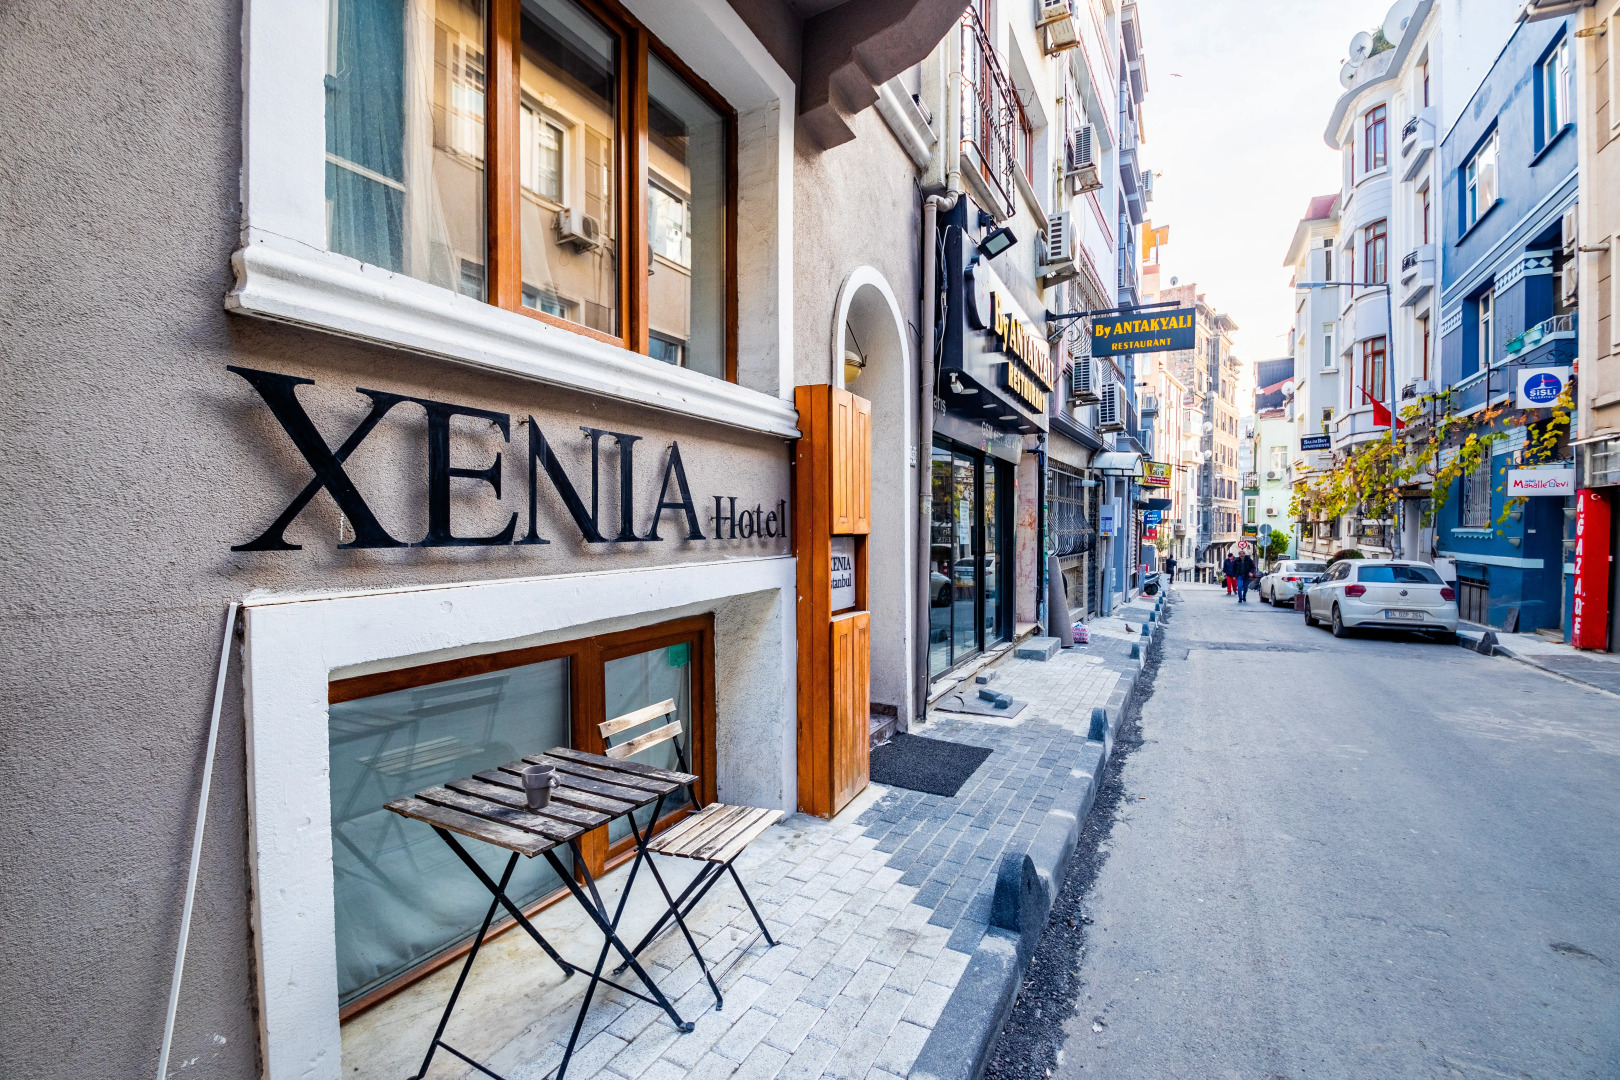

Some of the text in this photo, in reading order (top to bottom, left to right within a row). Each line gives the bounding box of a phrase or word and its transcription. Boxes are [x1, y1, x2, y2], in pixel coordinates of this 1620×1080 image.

[1095, 314, 1193, 339] By ANTAKYALI
[1111, 337, 1172, 351] RESTAURANT
[227, 365, 788, 552] XENIA Hotel
[831, 573, 852, 589] tanbul
